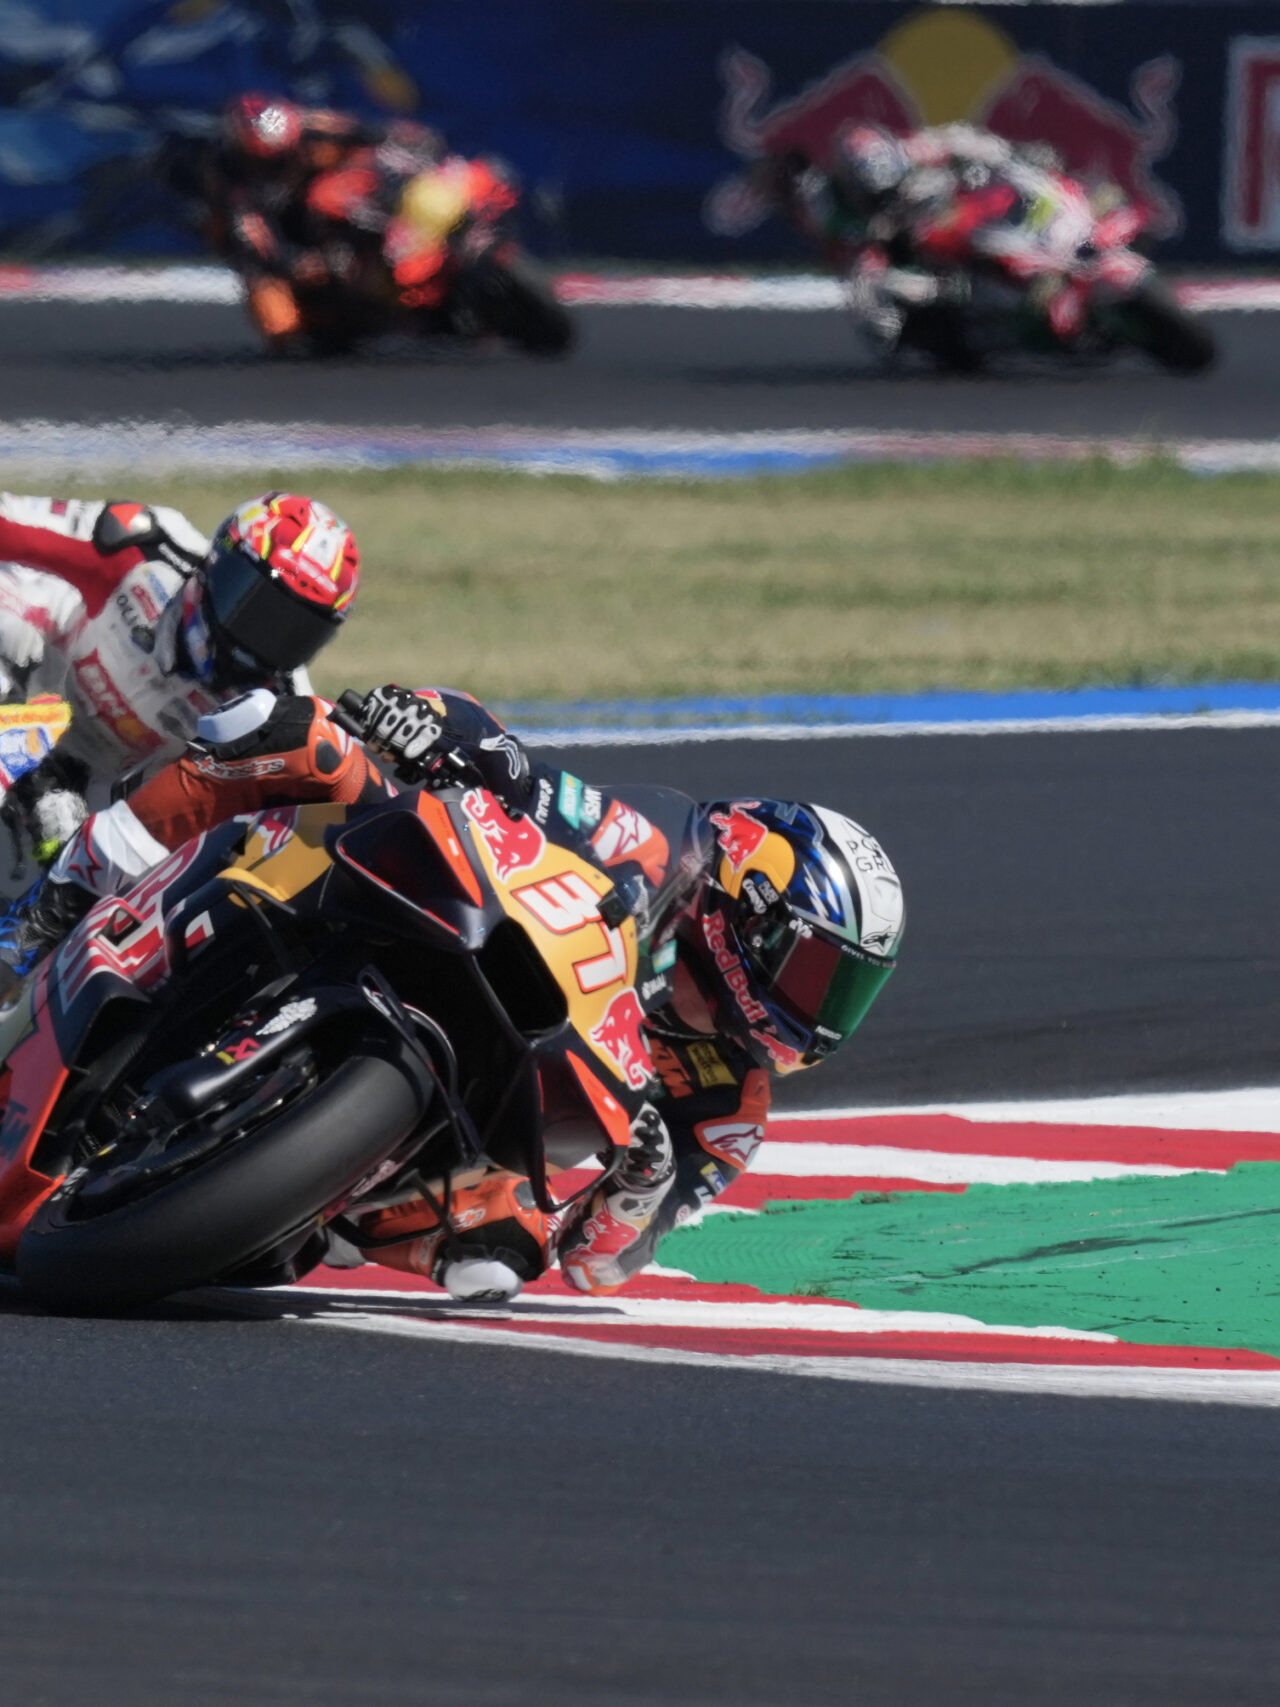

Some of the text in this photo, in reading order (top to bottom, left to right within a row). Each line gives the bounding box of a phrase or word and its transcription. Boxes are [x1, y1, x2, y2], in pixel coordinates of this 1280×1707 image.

[510, 870, 628, 994] 37
[703, 909, 768, 1023] Red Bull
